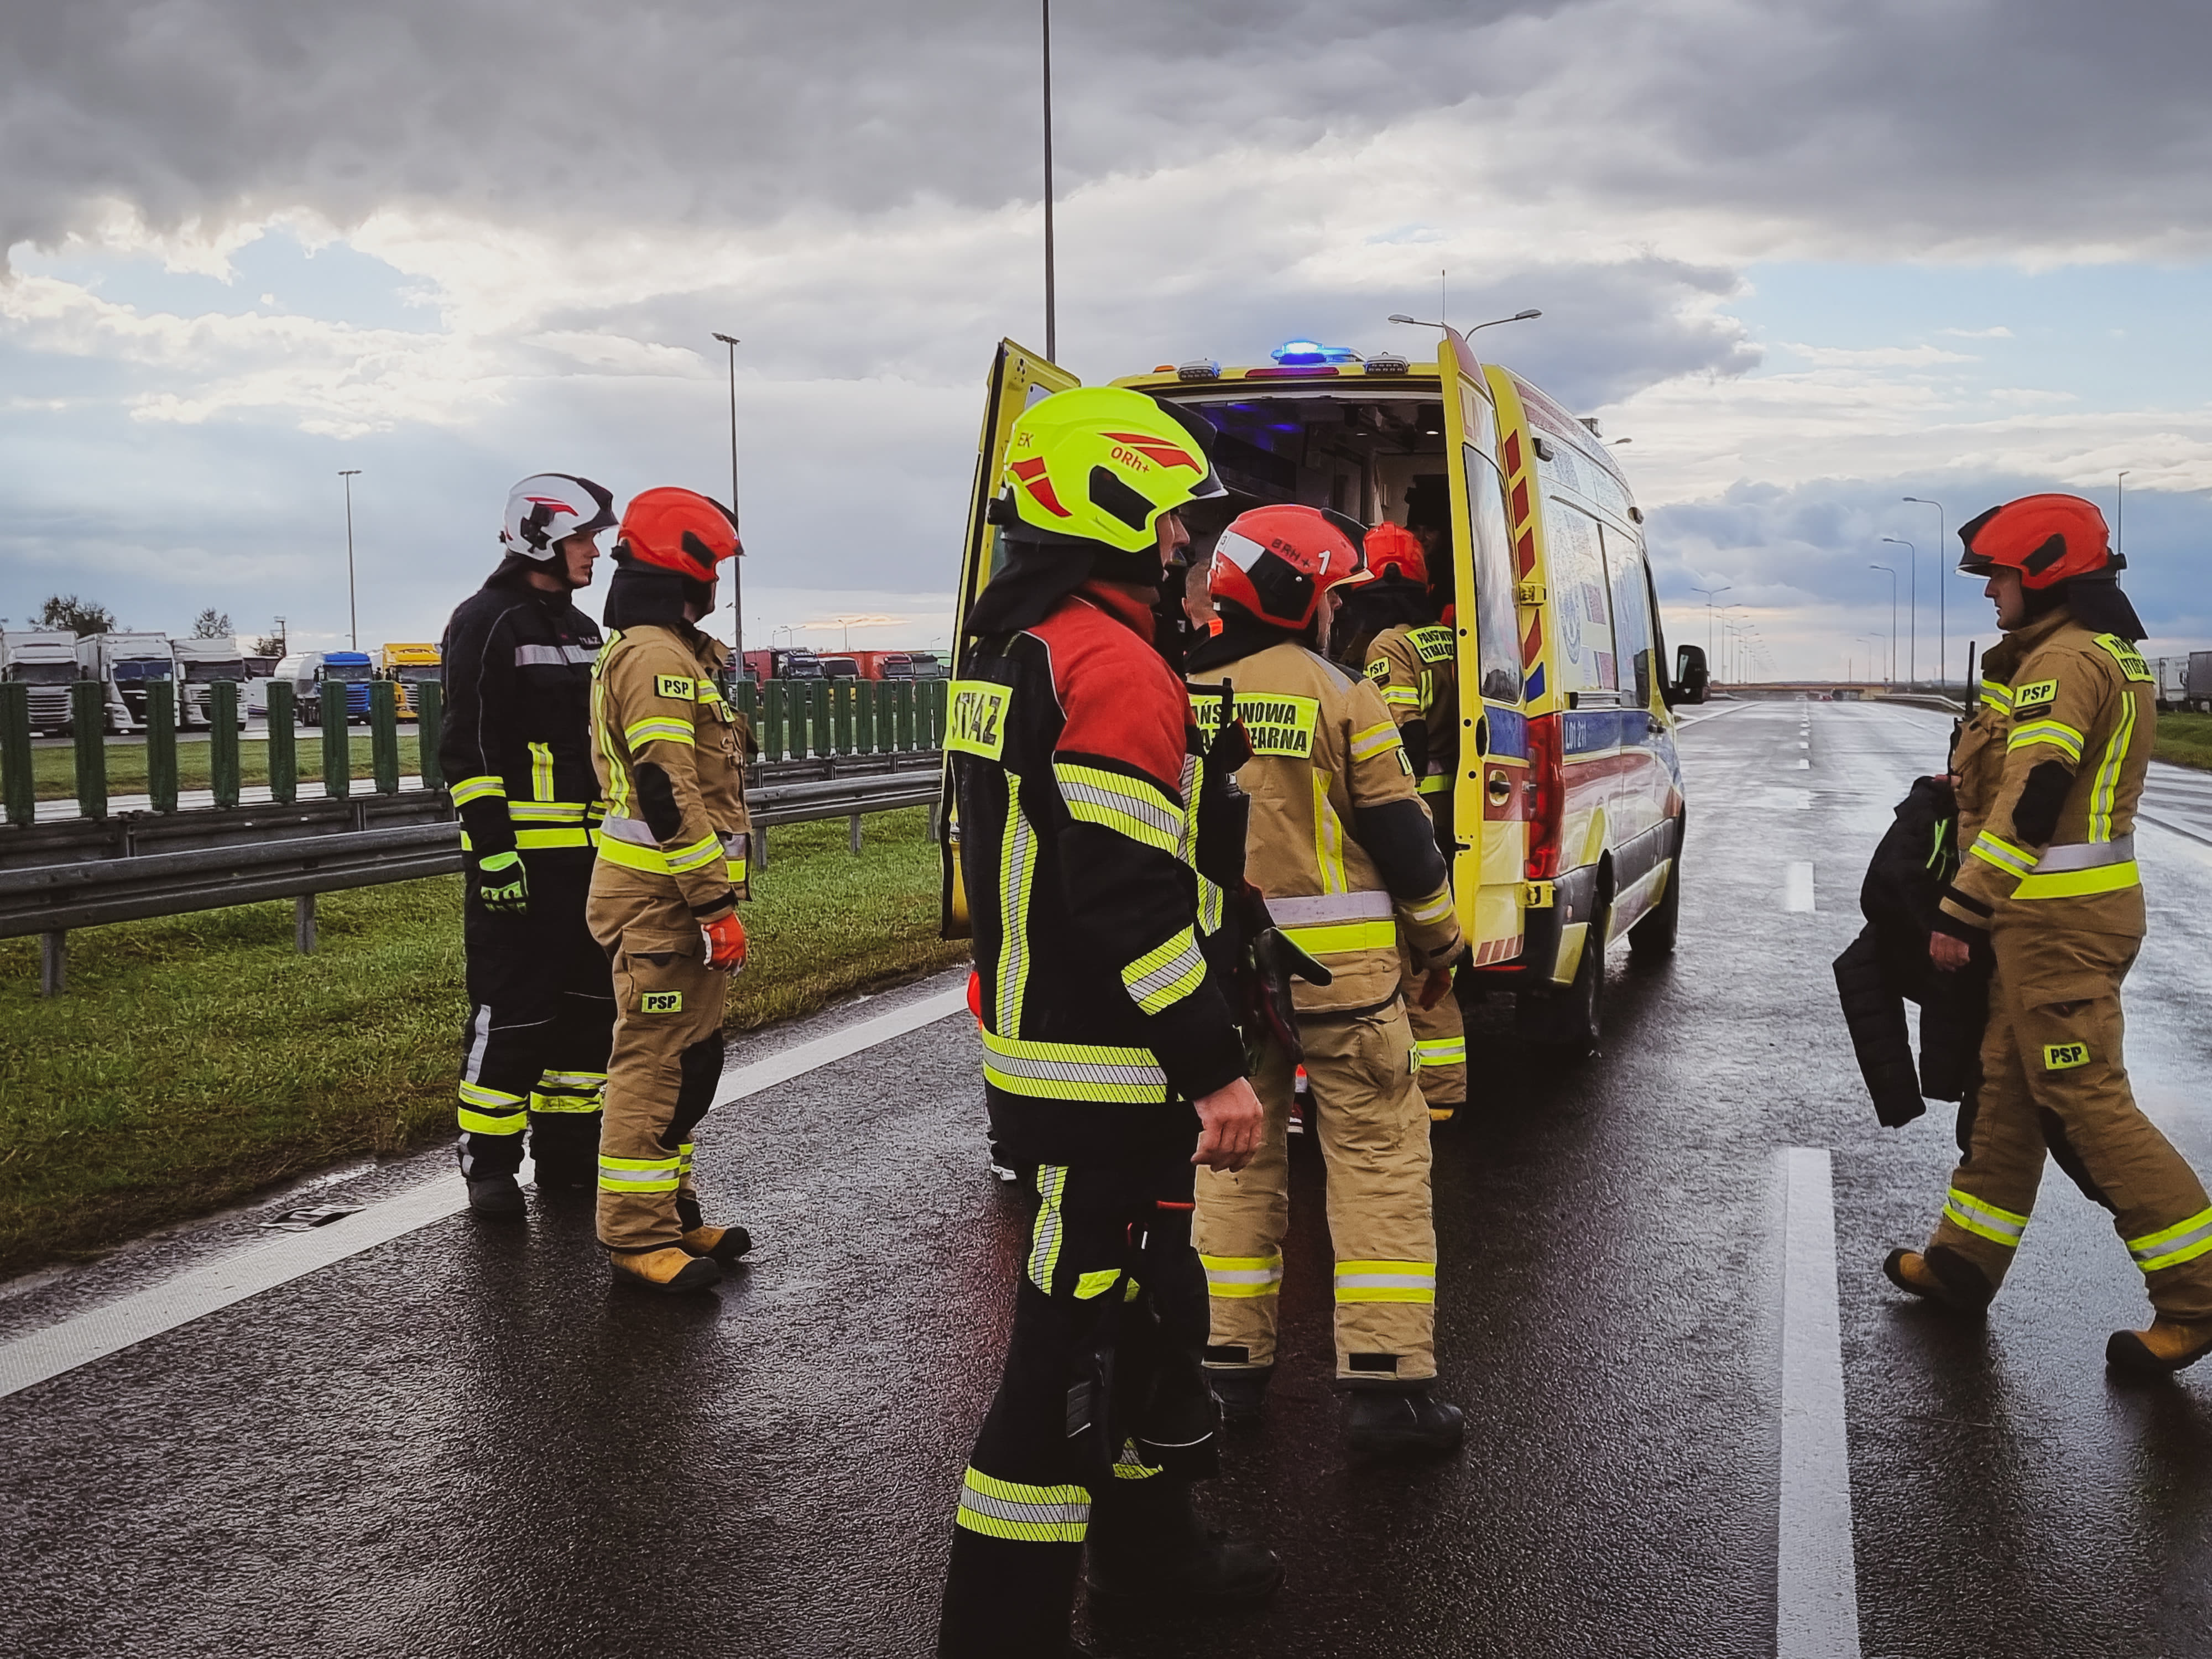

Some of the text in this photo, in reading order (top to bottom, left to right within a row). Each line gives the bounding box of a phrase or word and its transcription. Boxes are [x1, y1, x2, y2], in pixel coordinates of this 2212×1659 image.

[1318, 550, 1331, 576] 1
[1370, 661, 1385, 677] PSP
[664, 680, 688, 695] PSP
[2021, 685, 2051, 702] PSP
[1245, 727, 1307, 752] ŻARNA
[648, 995, 676, 1009] PSP
[2051, 1046, 2081, 1064] PSP
